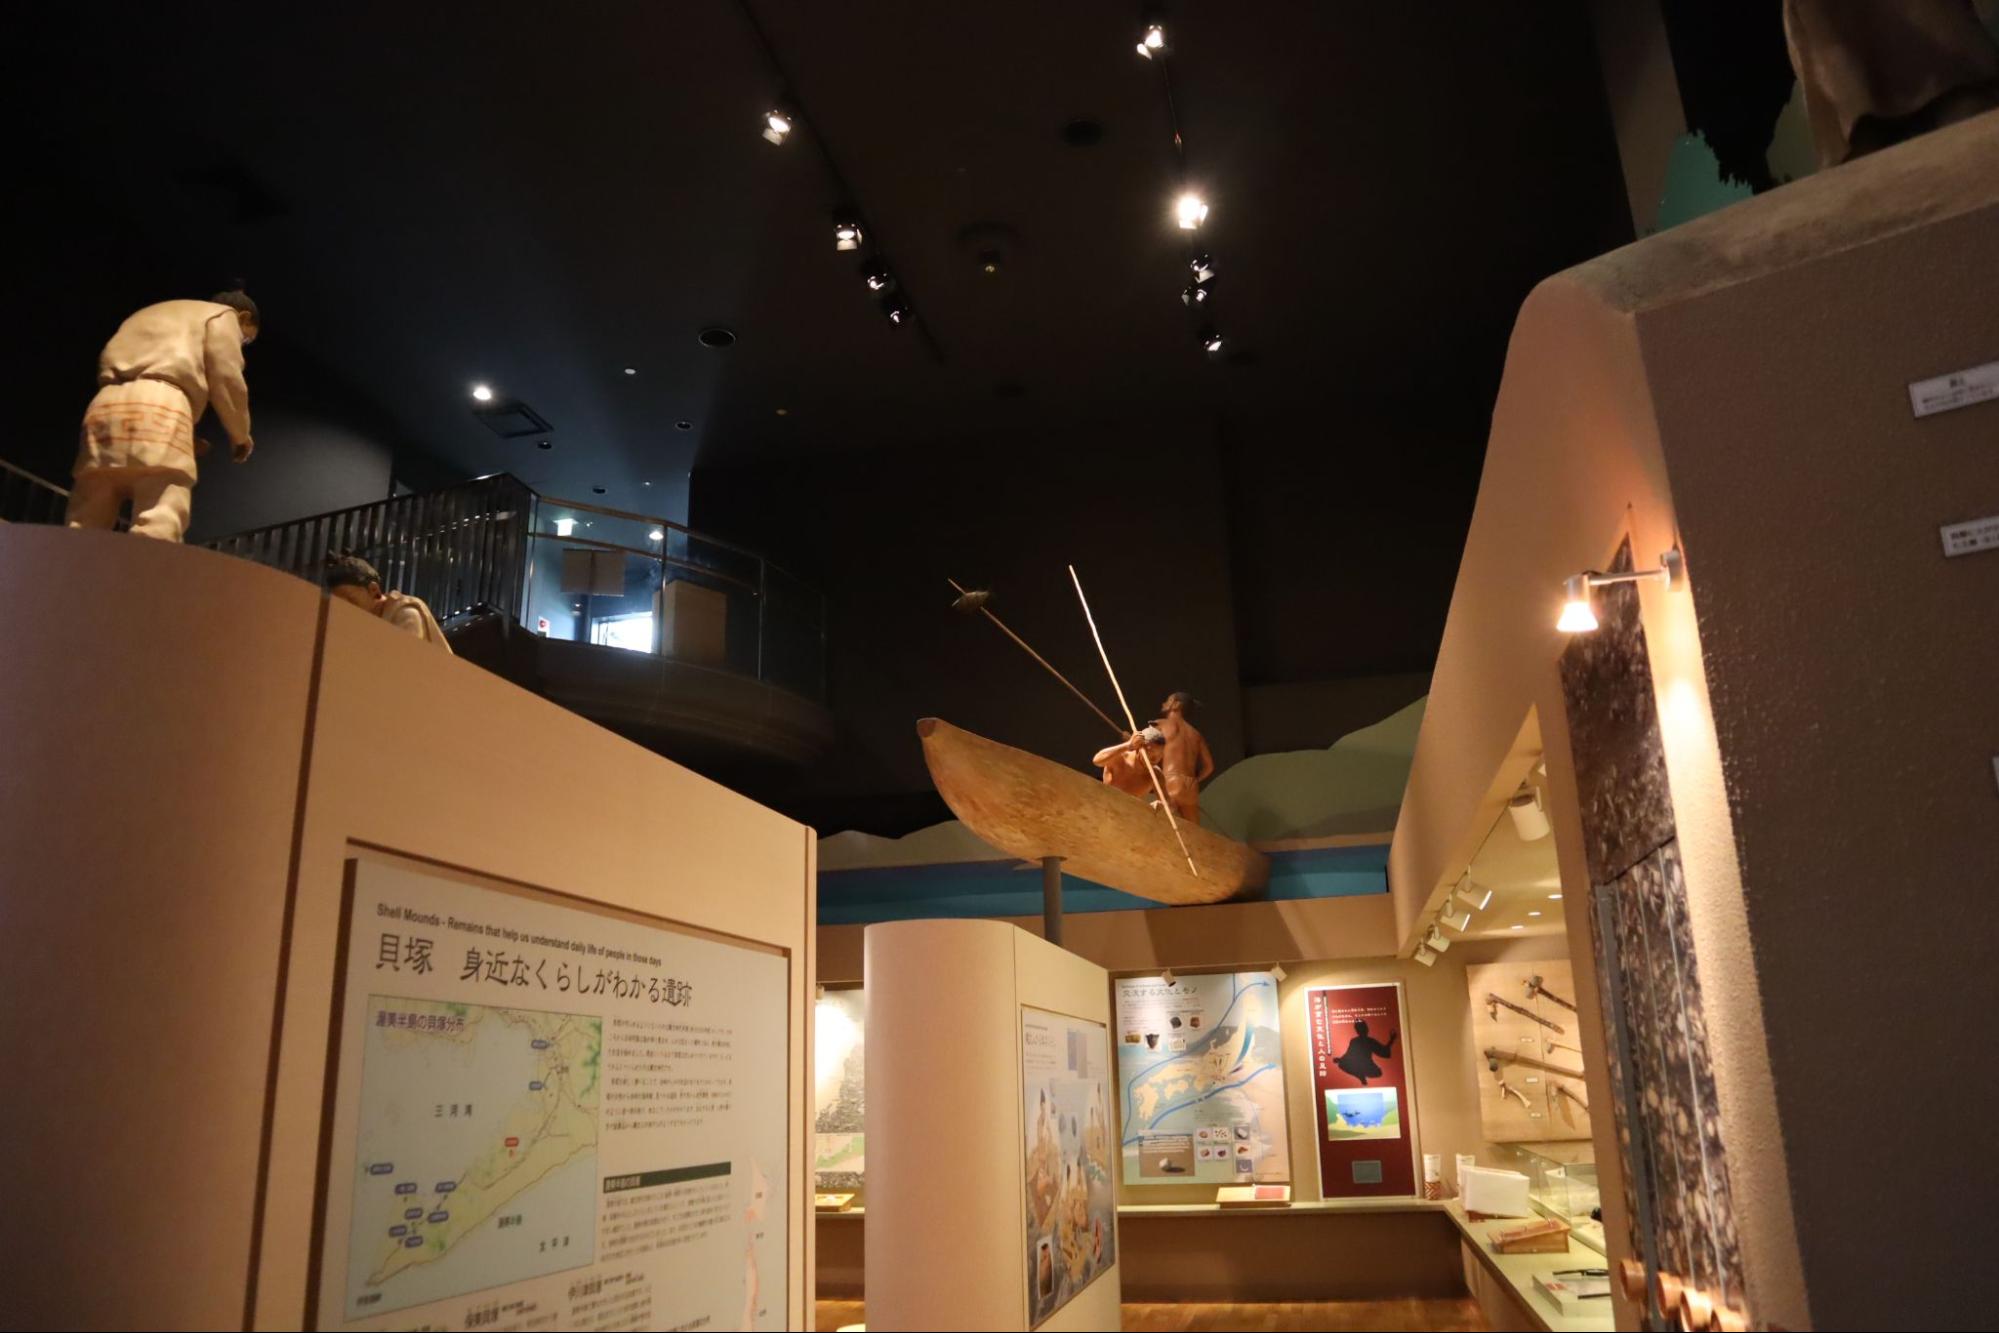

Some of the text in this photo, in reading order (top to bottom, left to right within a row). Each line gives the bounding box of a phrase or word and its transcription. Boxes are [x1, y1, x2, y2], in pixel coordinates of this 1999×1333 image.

[376, 933, 693, 1008] 貝塚 身近なくらしがわかる遺跡
[377, 903, 401, 919] Shell
[404, 907, 440, 926] Mounds
[447, 917, 484, 935] Remains
[485, 925, 501, 936] that
[502, 929, 519, 943] help
[520, 934, 529, 943] us
[530, 934, 570, 950] understand
[570, 941, 586, 956] daily
[587, 944, 597, 955] life
[598, 946, 605, 956] of
[605, 948, 625, 962] people
[626, 952, 632, 961] in
[633, 953, 648, 965] those
[649, 954, 662, 968] days
